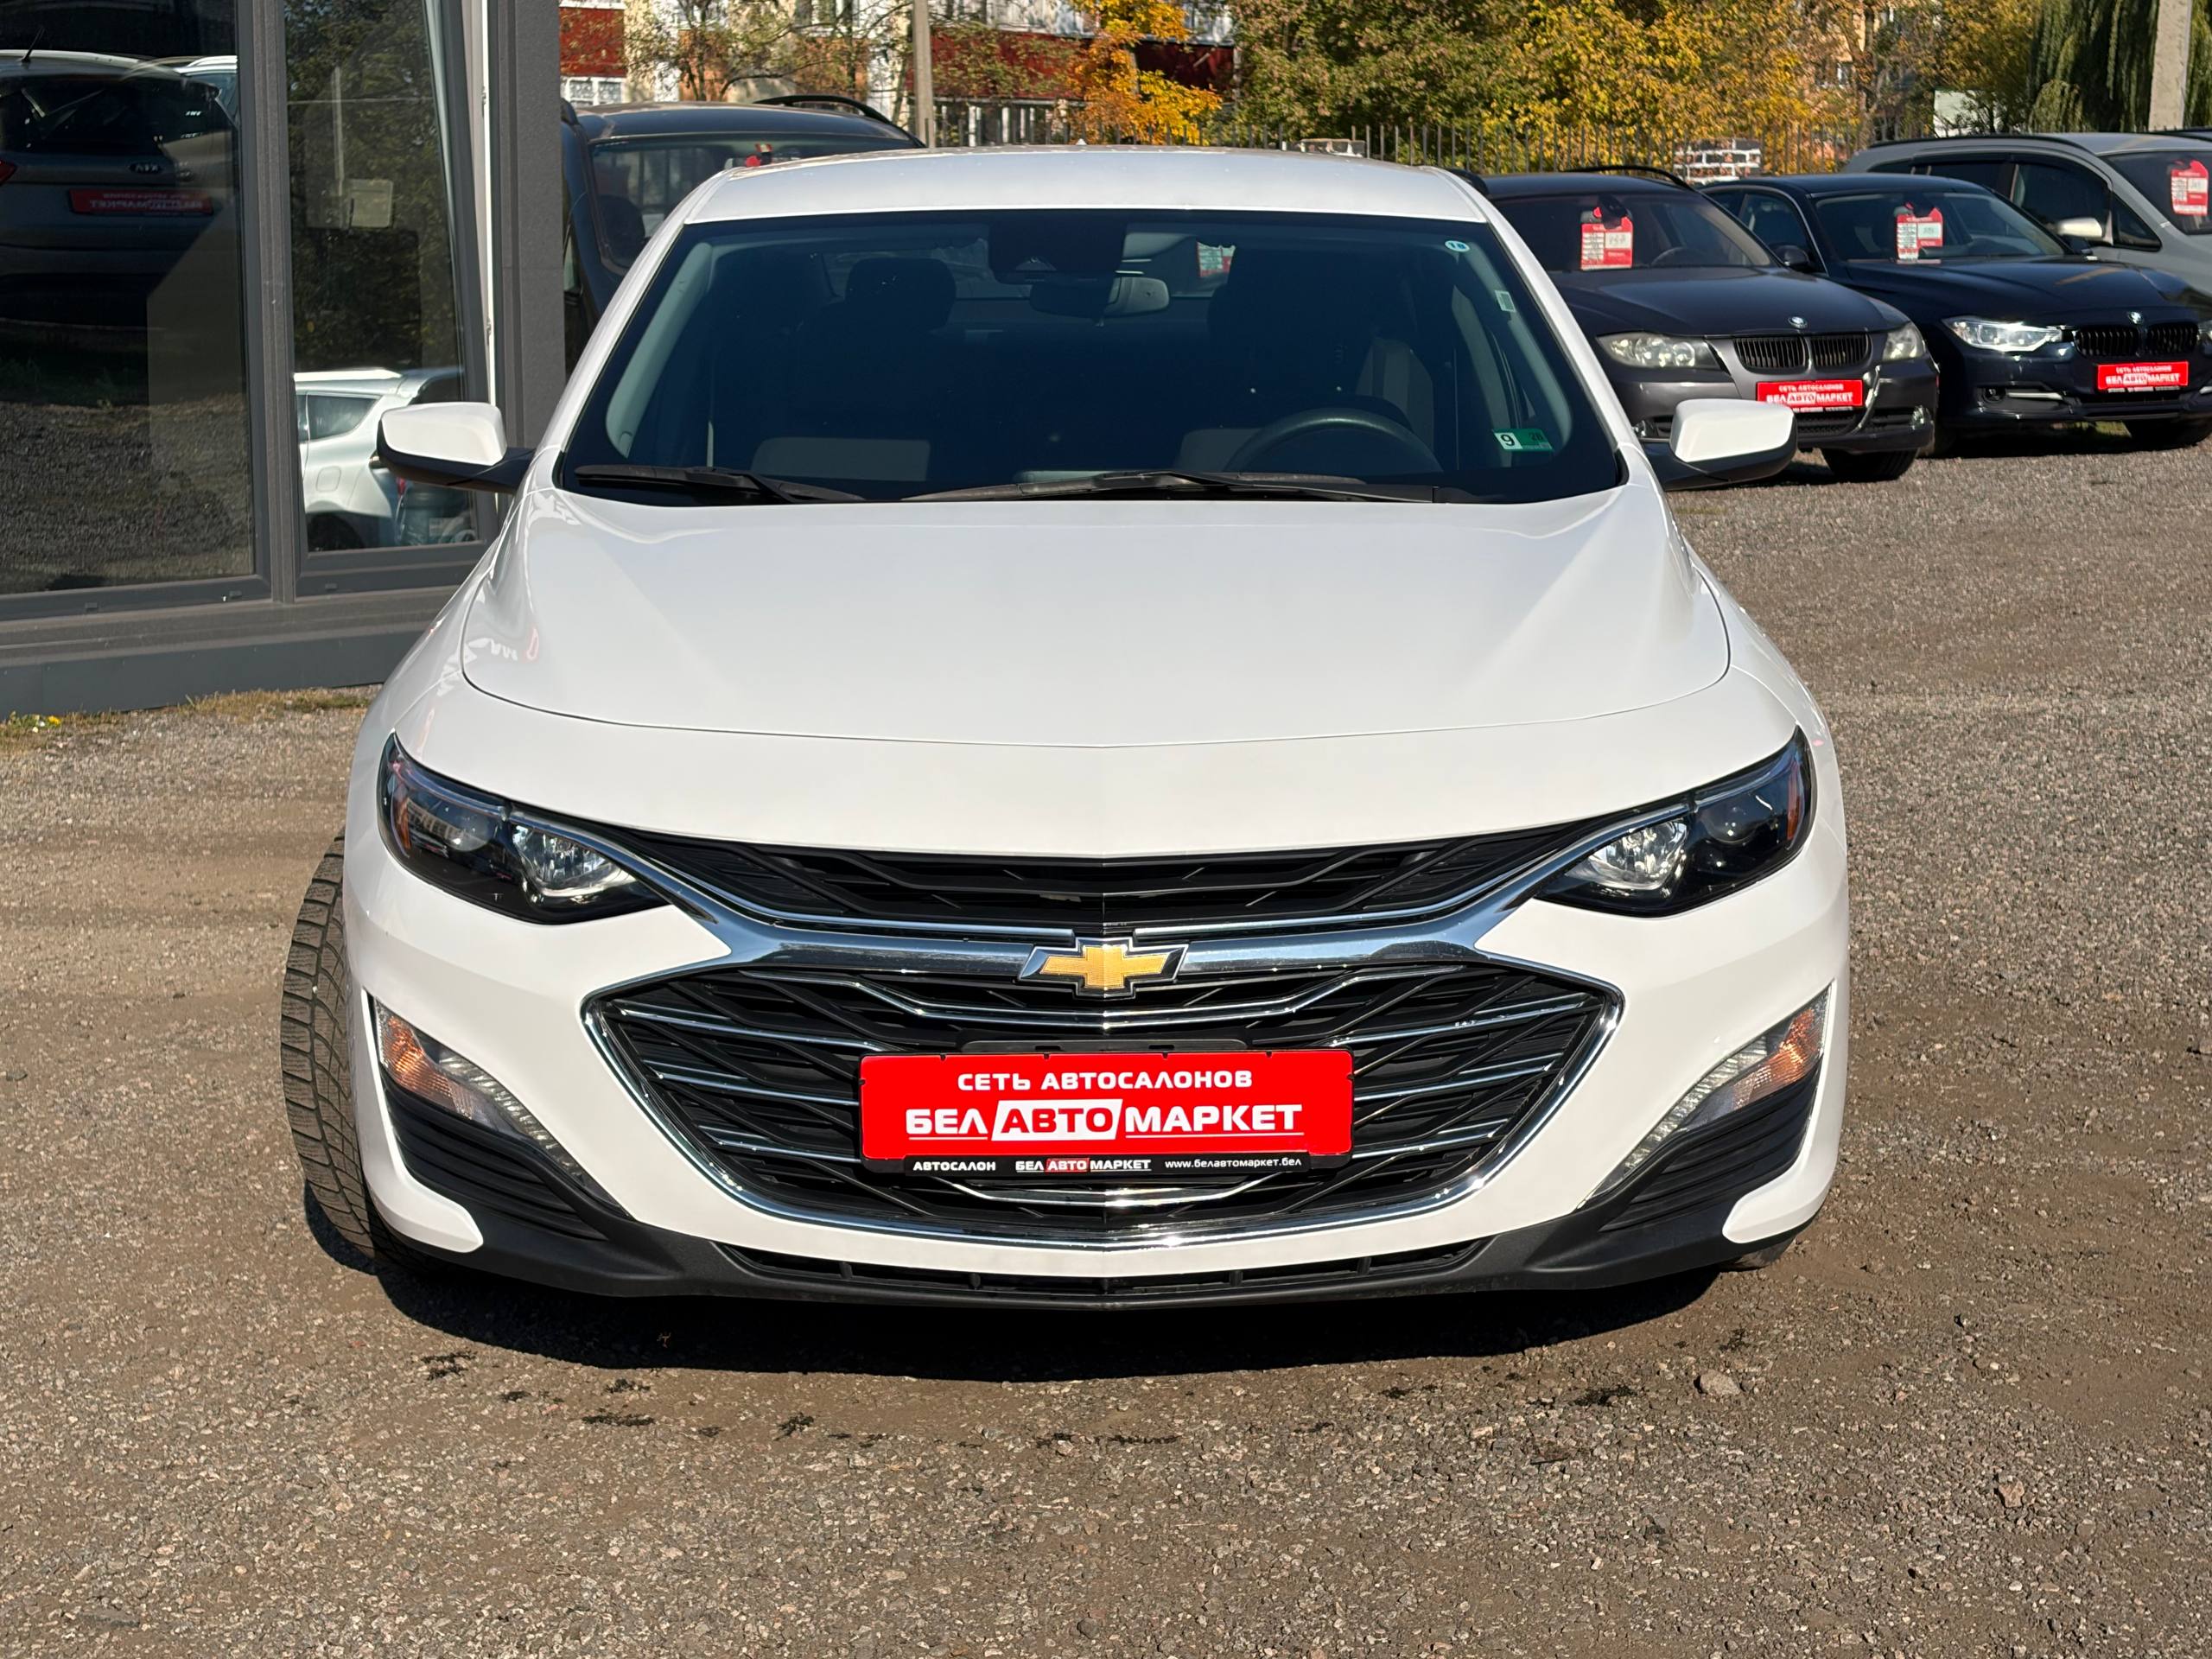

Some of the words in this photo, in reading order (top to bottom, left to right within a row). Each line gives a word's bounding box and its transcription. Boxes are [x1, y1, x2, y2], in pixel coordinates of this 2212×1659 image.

[1816, 392, 1853, 402] МАРКЕТ
[1500, 434, 1516, 447] 9
[957, 1072, 1031, 1091] СЕТЬ
[1040, 1070, 1252, 1090] АВТОСАЛОНОВ
[912, 1160, 996, 1172] АВТОСАЛОН
[1165, 1157, 1302, 1169] www.белавтомаркет.бел
